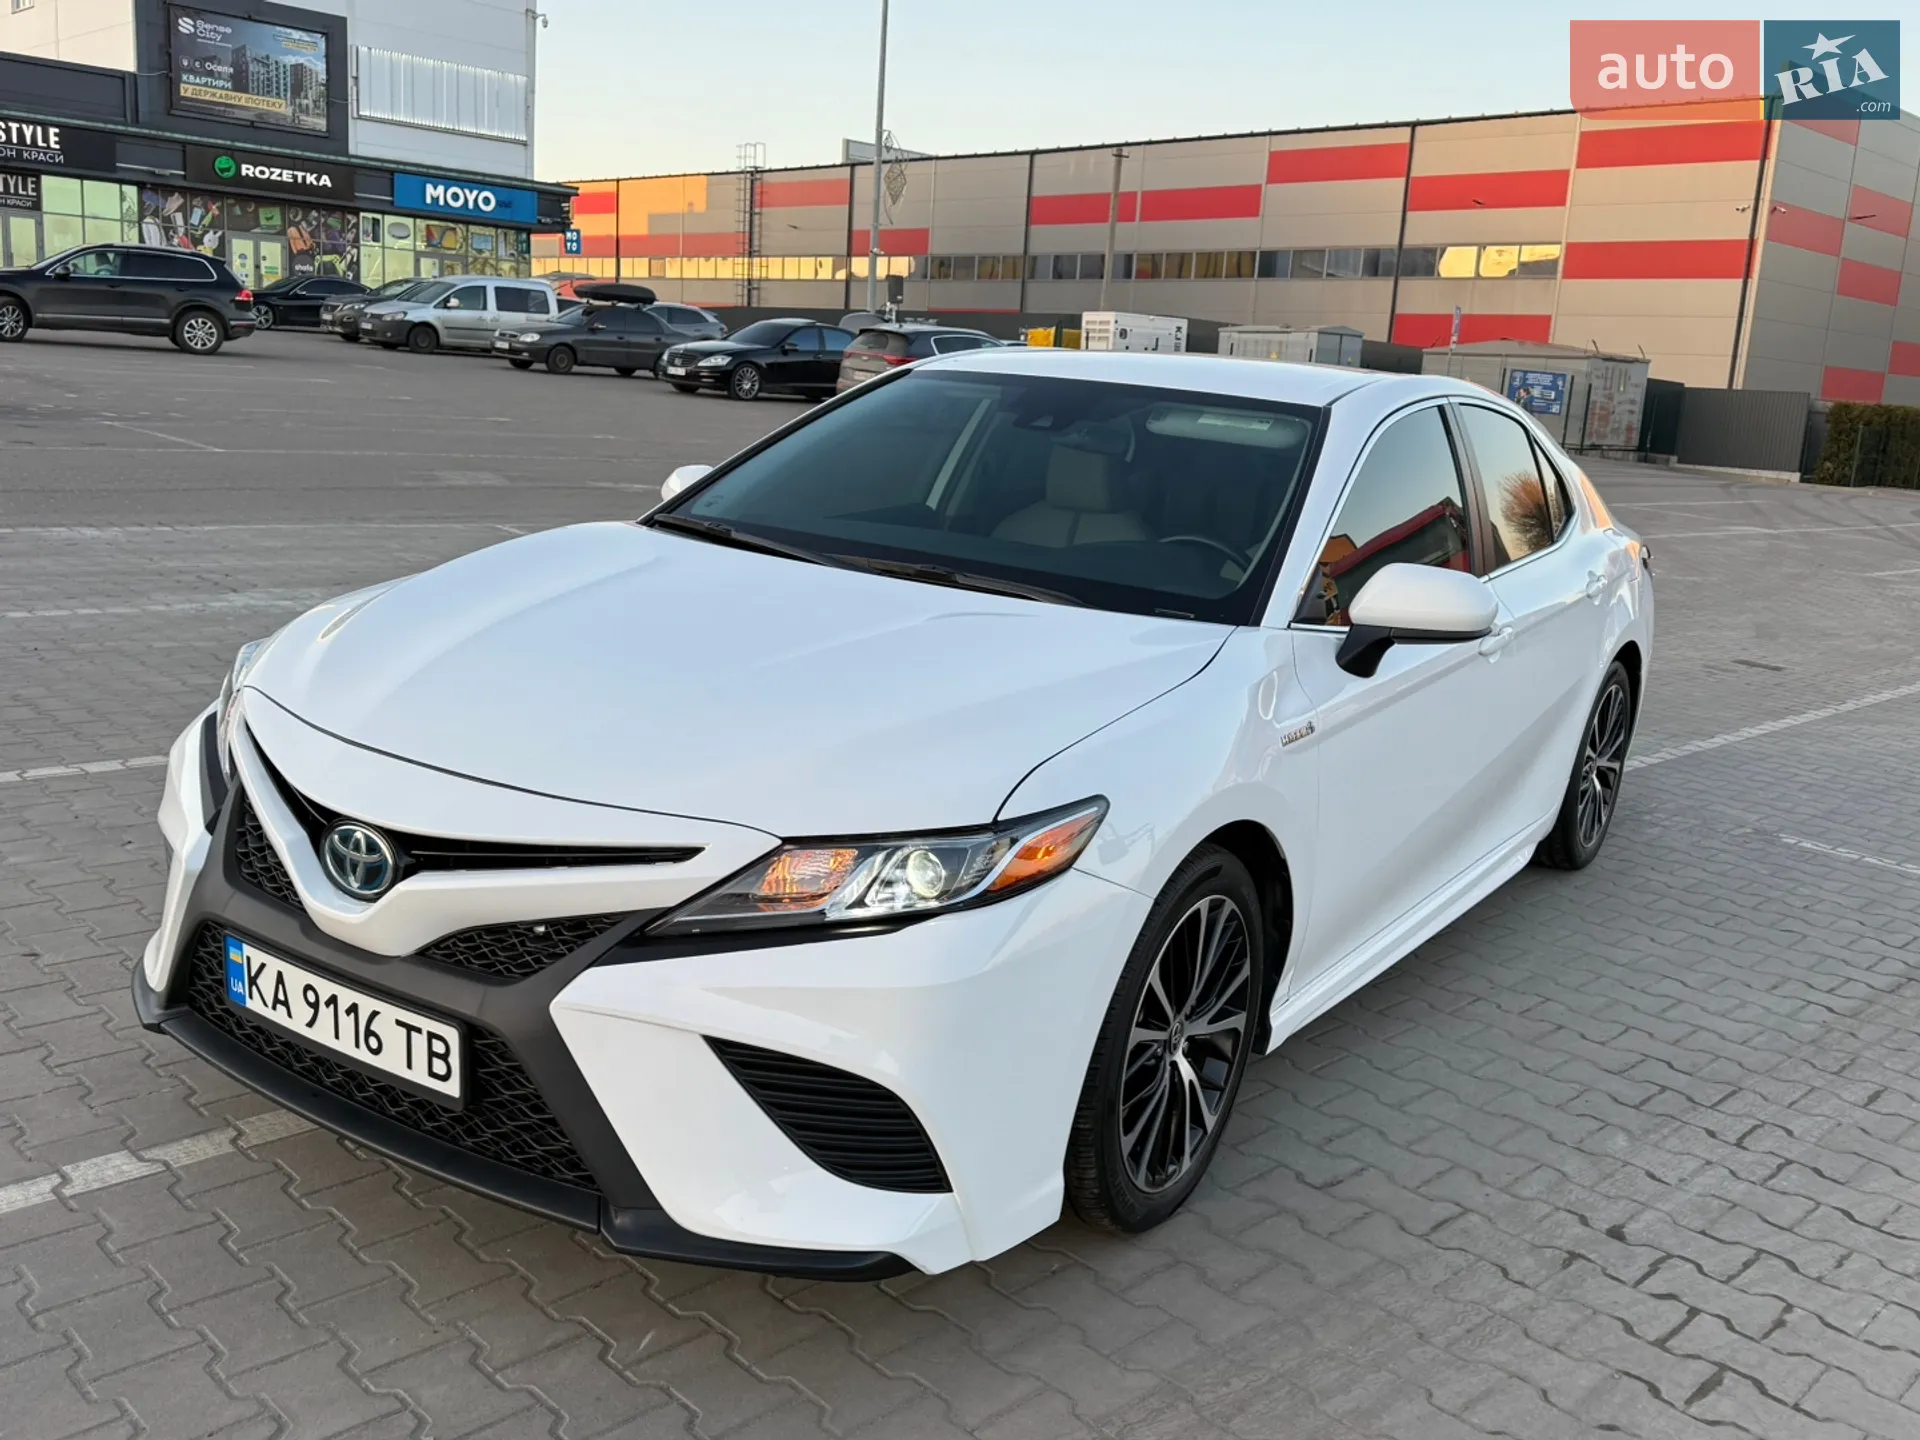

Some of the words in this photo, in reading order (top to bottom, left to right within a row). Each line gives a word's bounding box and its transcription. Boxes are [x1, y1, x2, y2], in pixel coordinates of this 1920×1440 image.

[181, 73, 232, 90] КВАРТИРИ
[182, 86, 189, 96] У
[191, 88, 243, 103] ДЕРЖАВНУ
[23, 150, 64, 164] КРАСИ
[241, 163, 332, 188] ROZETKA
[425, 183, 496, 212] MOYO
[231, 976, 244, 996] UA
[246, 955, 293, 1019] KA
[302, 983, 383, 1056] 9116
[395, 1018, 452, 1083] TB
